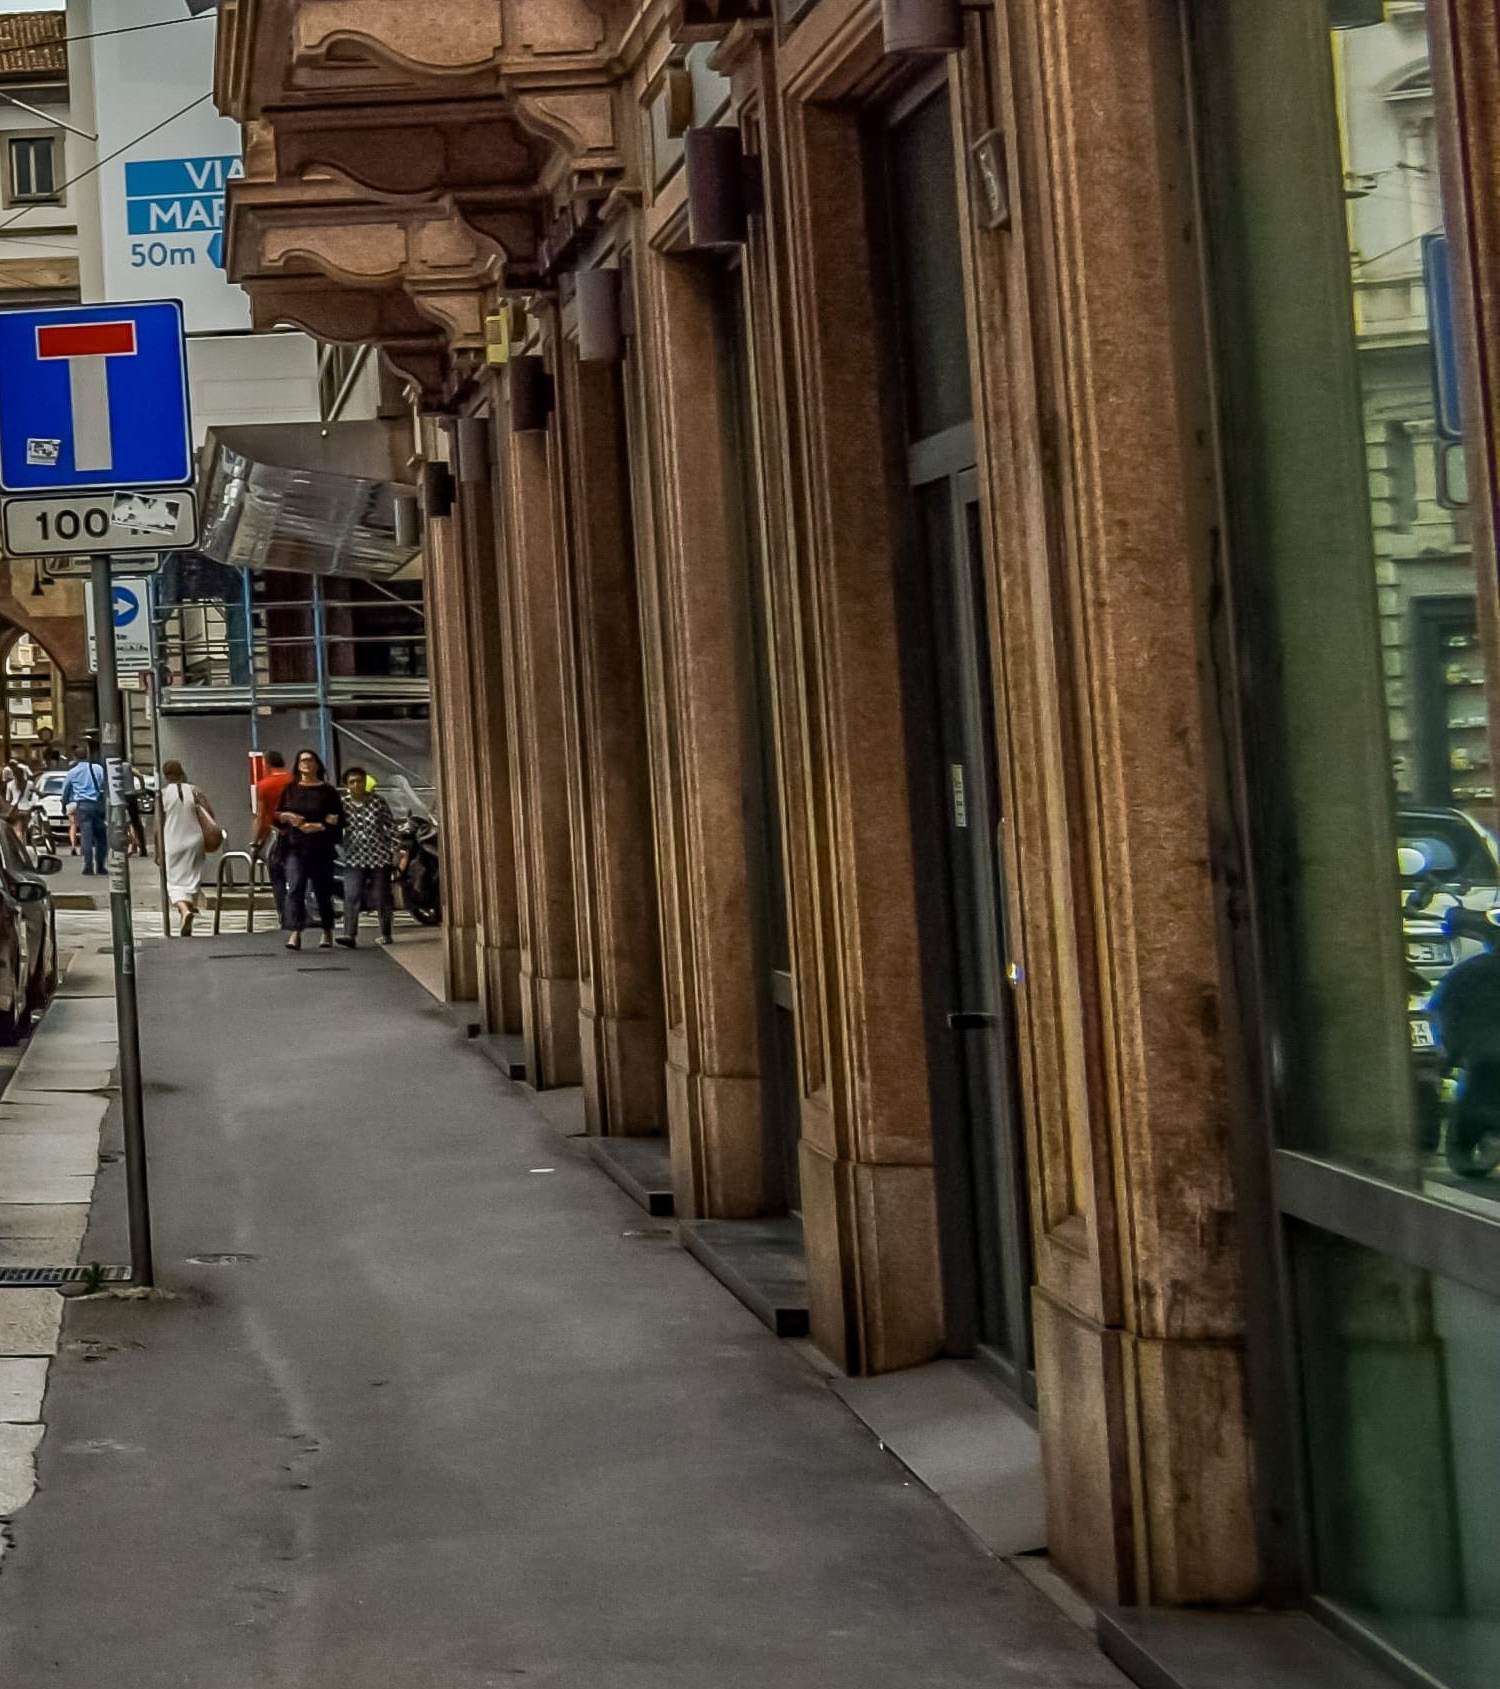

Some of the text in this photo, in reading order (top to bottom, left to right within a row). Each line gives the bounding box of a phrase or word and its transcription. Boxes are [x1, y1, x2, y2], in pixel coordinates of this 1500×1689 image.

[184, 159, 245, 190] VIA
[131, 241, 196, 267] 50m
[35, 508, 110, 541] 100
